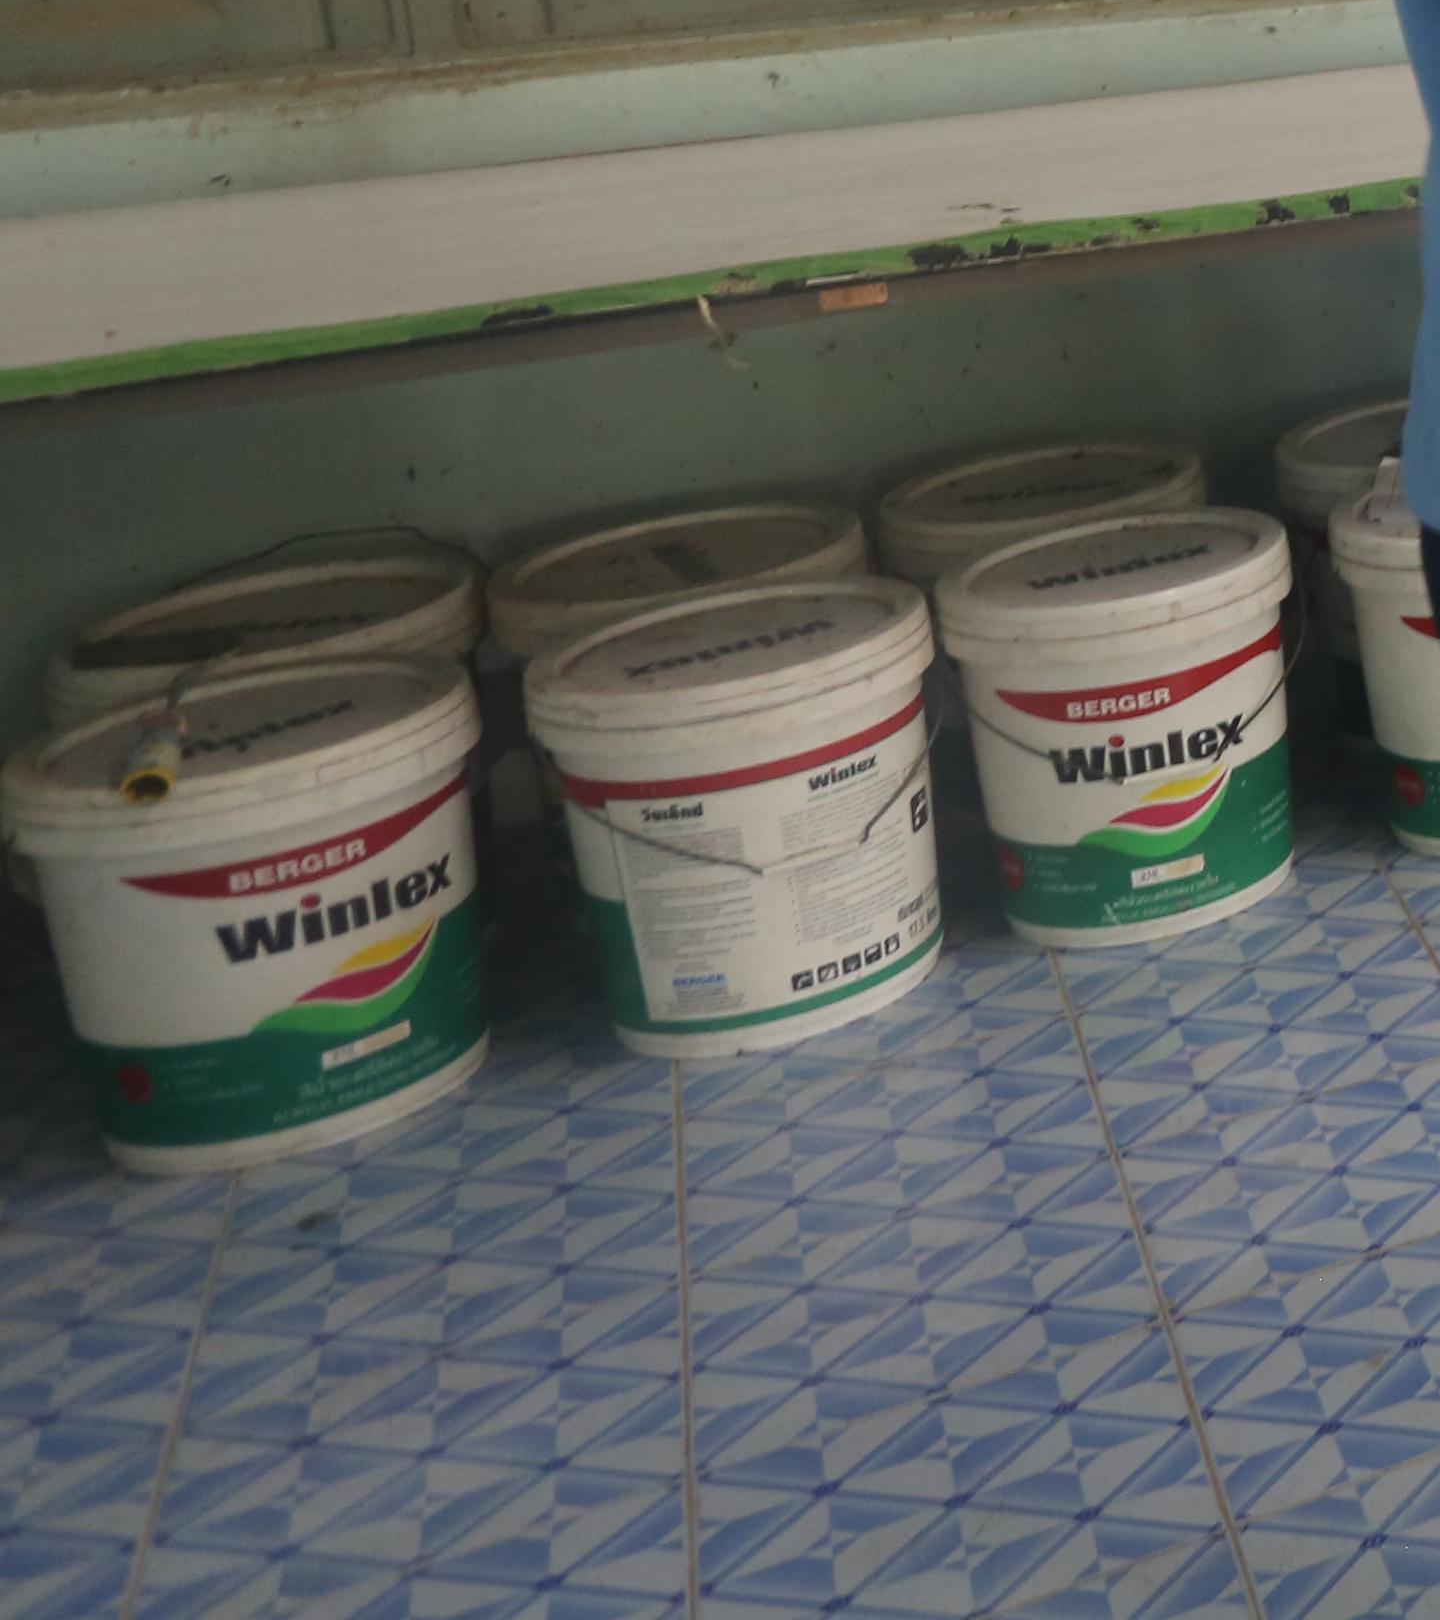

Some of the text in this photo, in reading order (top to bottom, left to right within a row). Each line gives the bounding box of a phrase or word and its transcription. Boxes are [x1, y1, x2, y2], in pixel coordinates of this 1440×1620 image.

[1066, 687, 1172, 720] BERGER
[807, 754, 878, 791] Winlex
[1050, 713, 1244, 783] Winlex
[229, 838, 368, 894] BERGER
[215, 853, 453, 964] Winlex
